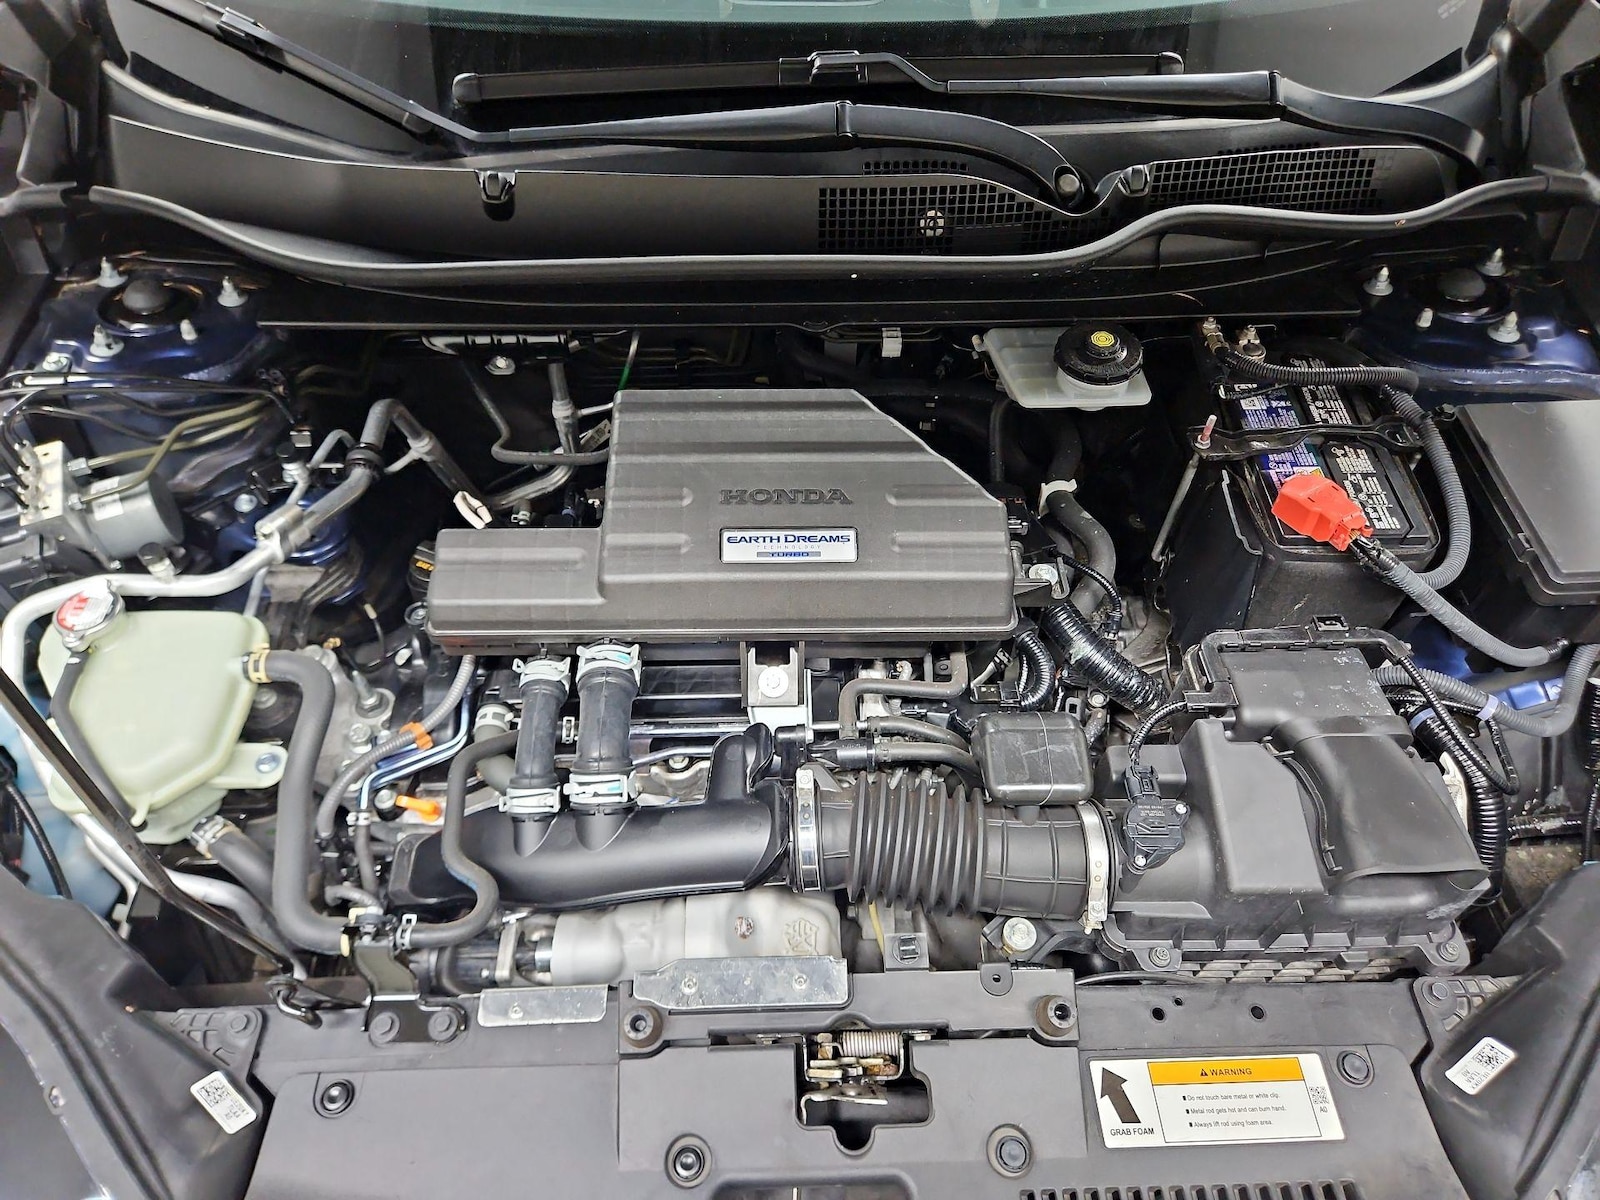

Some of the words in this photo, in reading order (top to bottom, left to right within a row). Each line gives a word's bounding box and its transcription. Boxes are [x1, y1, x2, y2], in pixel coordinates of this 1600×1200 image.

[719, 488, 853, 505] HONDA
[726, 536, 781, 544] EARTH
[784, 534, 851, 544] DREAMS
[1210, 1068, 1253, 1076] WARNING
[1110, 1128, 1131, 1136] GRAB
[1133, 1127, 1155, 1135] FOAM
